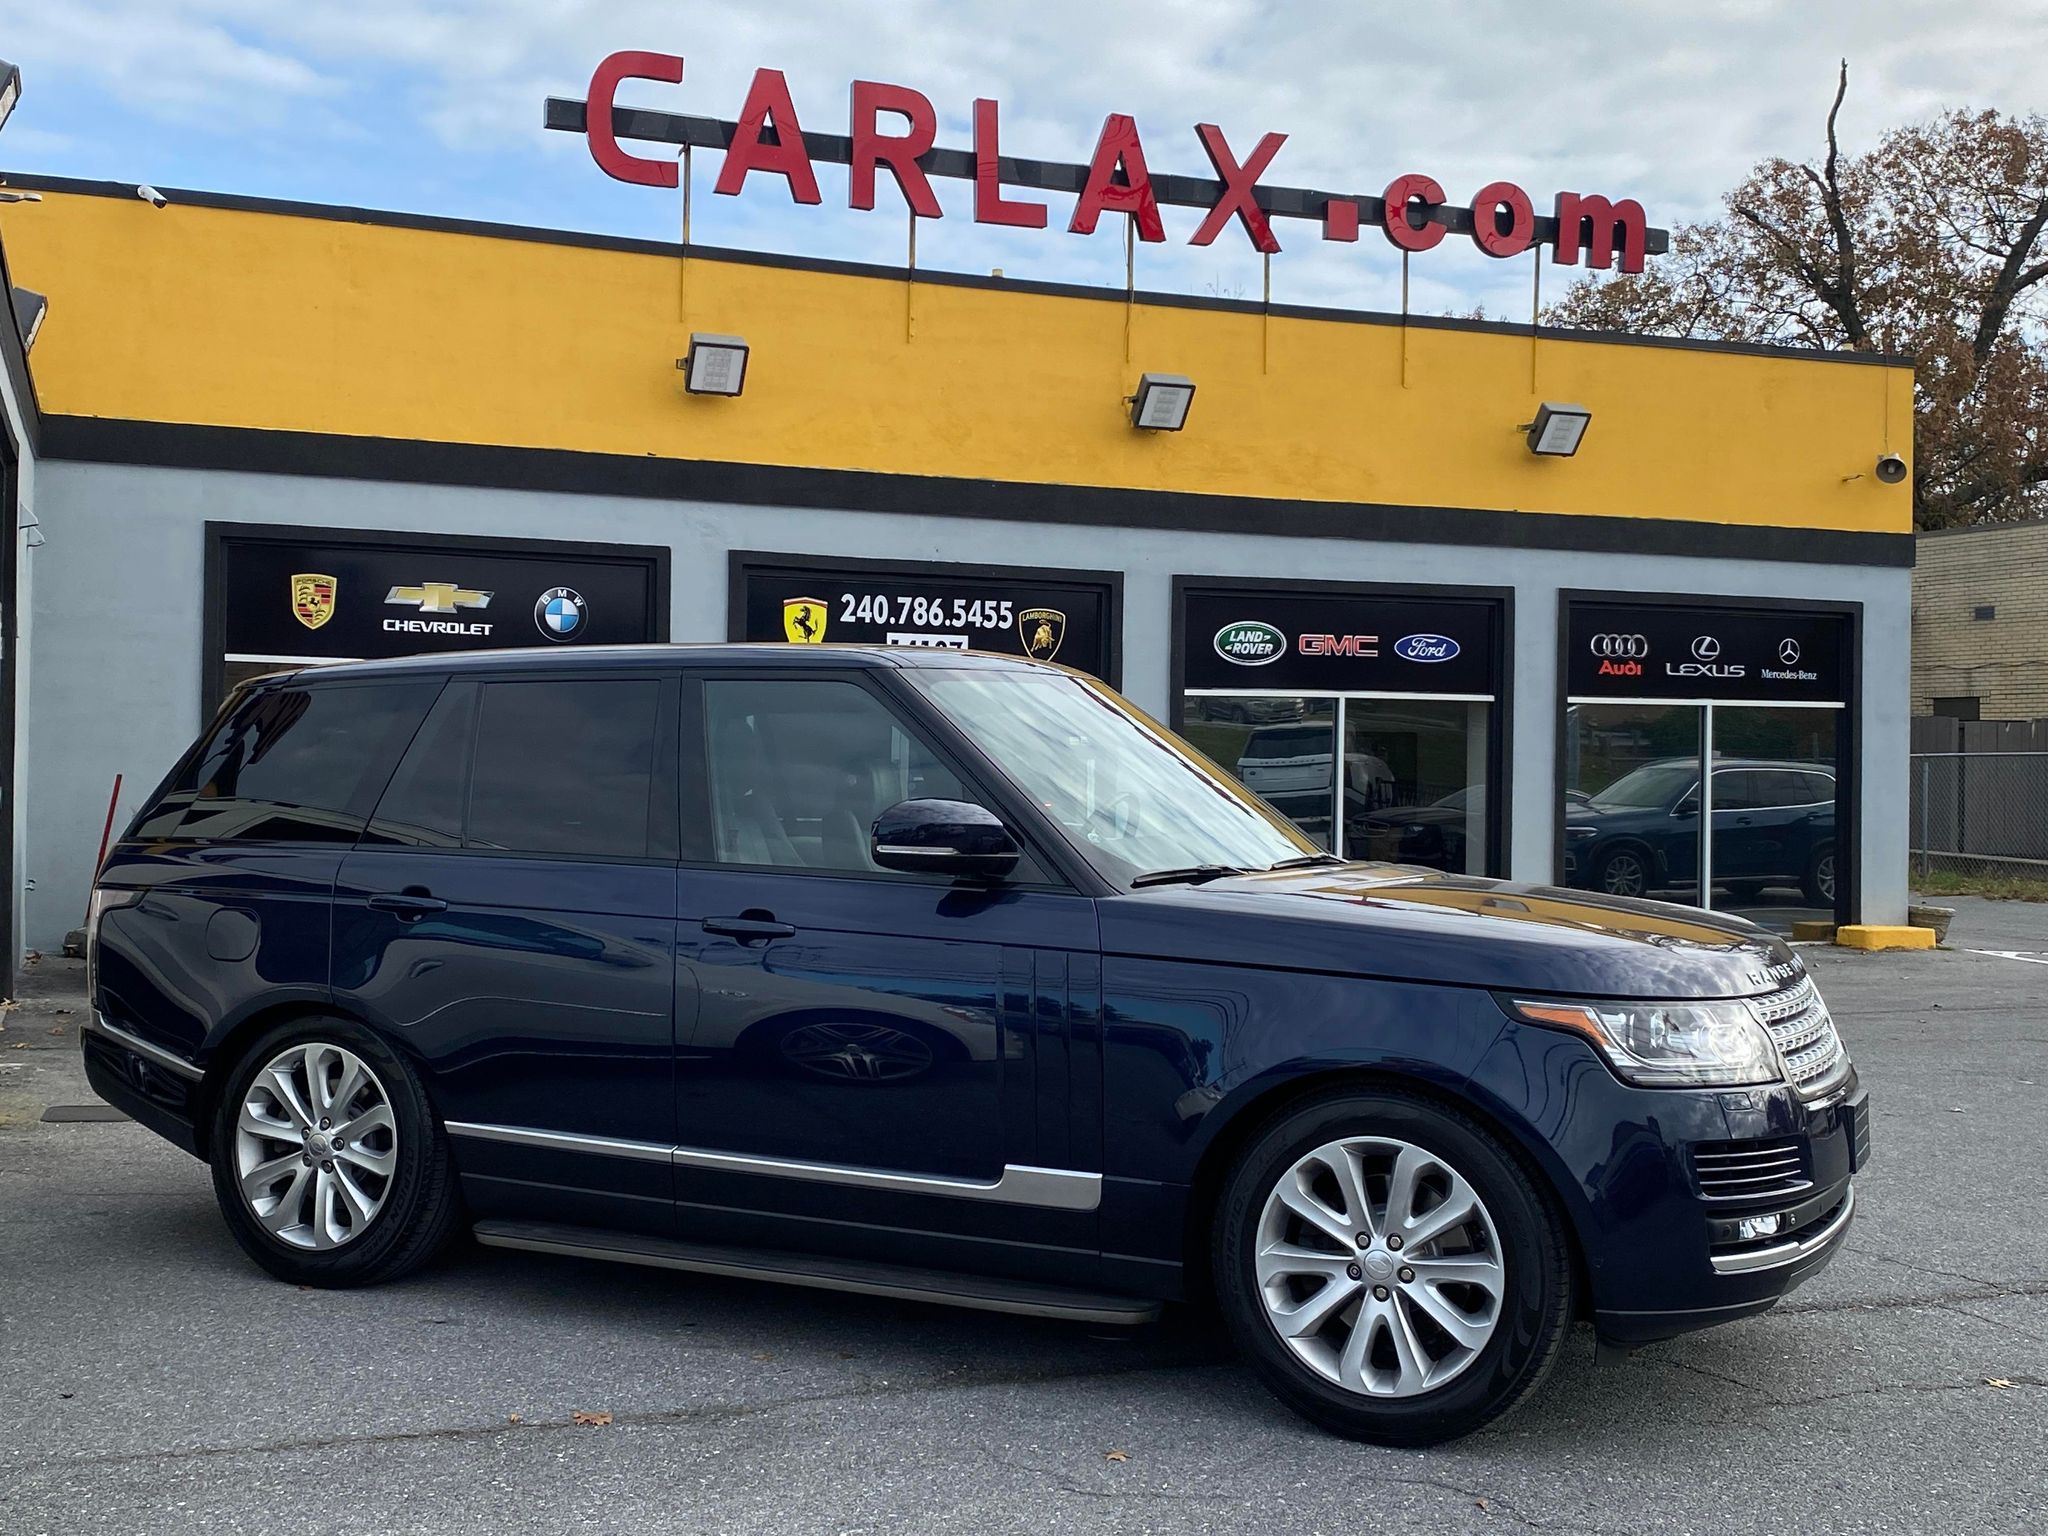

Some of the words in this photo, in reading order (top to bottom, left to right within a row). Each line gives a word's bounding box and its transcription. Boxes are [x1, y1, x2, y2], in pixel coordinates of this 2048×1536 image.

[541, 589, 584, 607] BMW
[839, 593, 1014, 630] 240.786.5455
[382, 619, 494, 636] CHEVROLET
[1229, 630, 1264, 643] LAND
[1298, 633, 1379, 657] GMC
[1231, 642, 1274, 655] ROVER
[1407, 637, 1447, 657] Ford
[1598, 660, 1642, 676] Audi
[1665, 662, 1746, 678] LEXUS
[1761, 668, 1818, 681] Mercedes-Benz
[1746, 962, 1794, 985] RANGE
